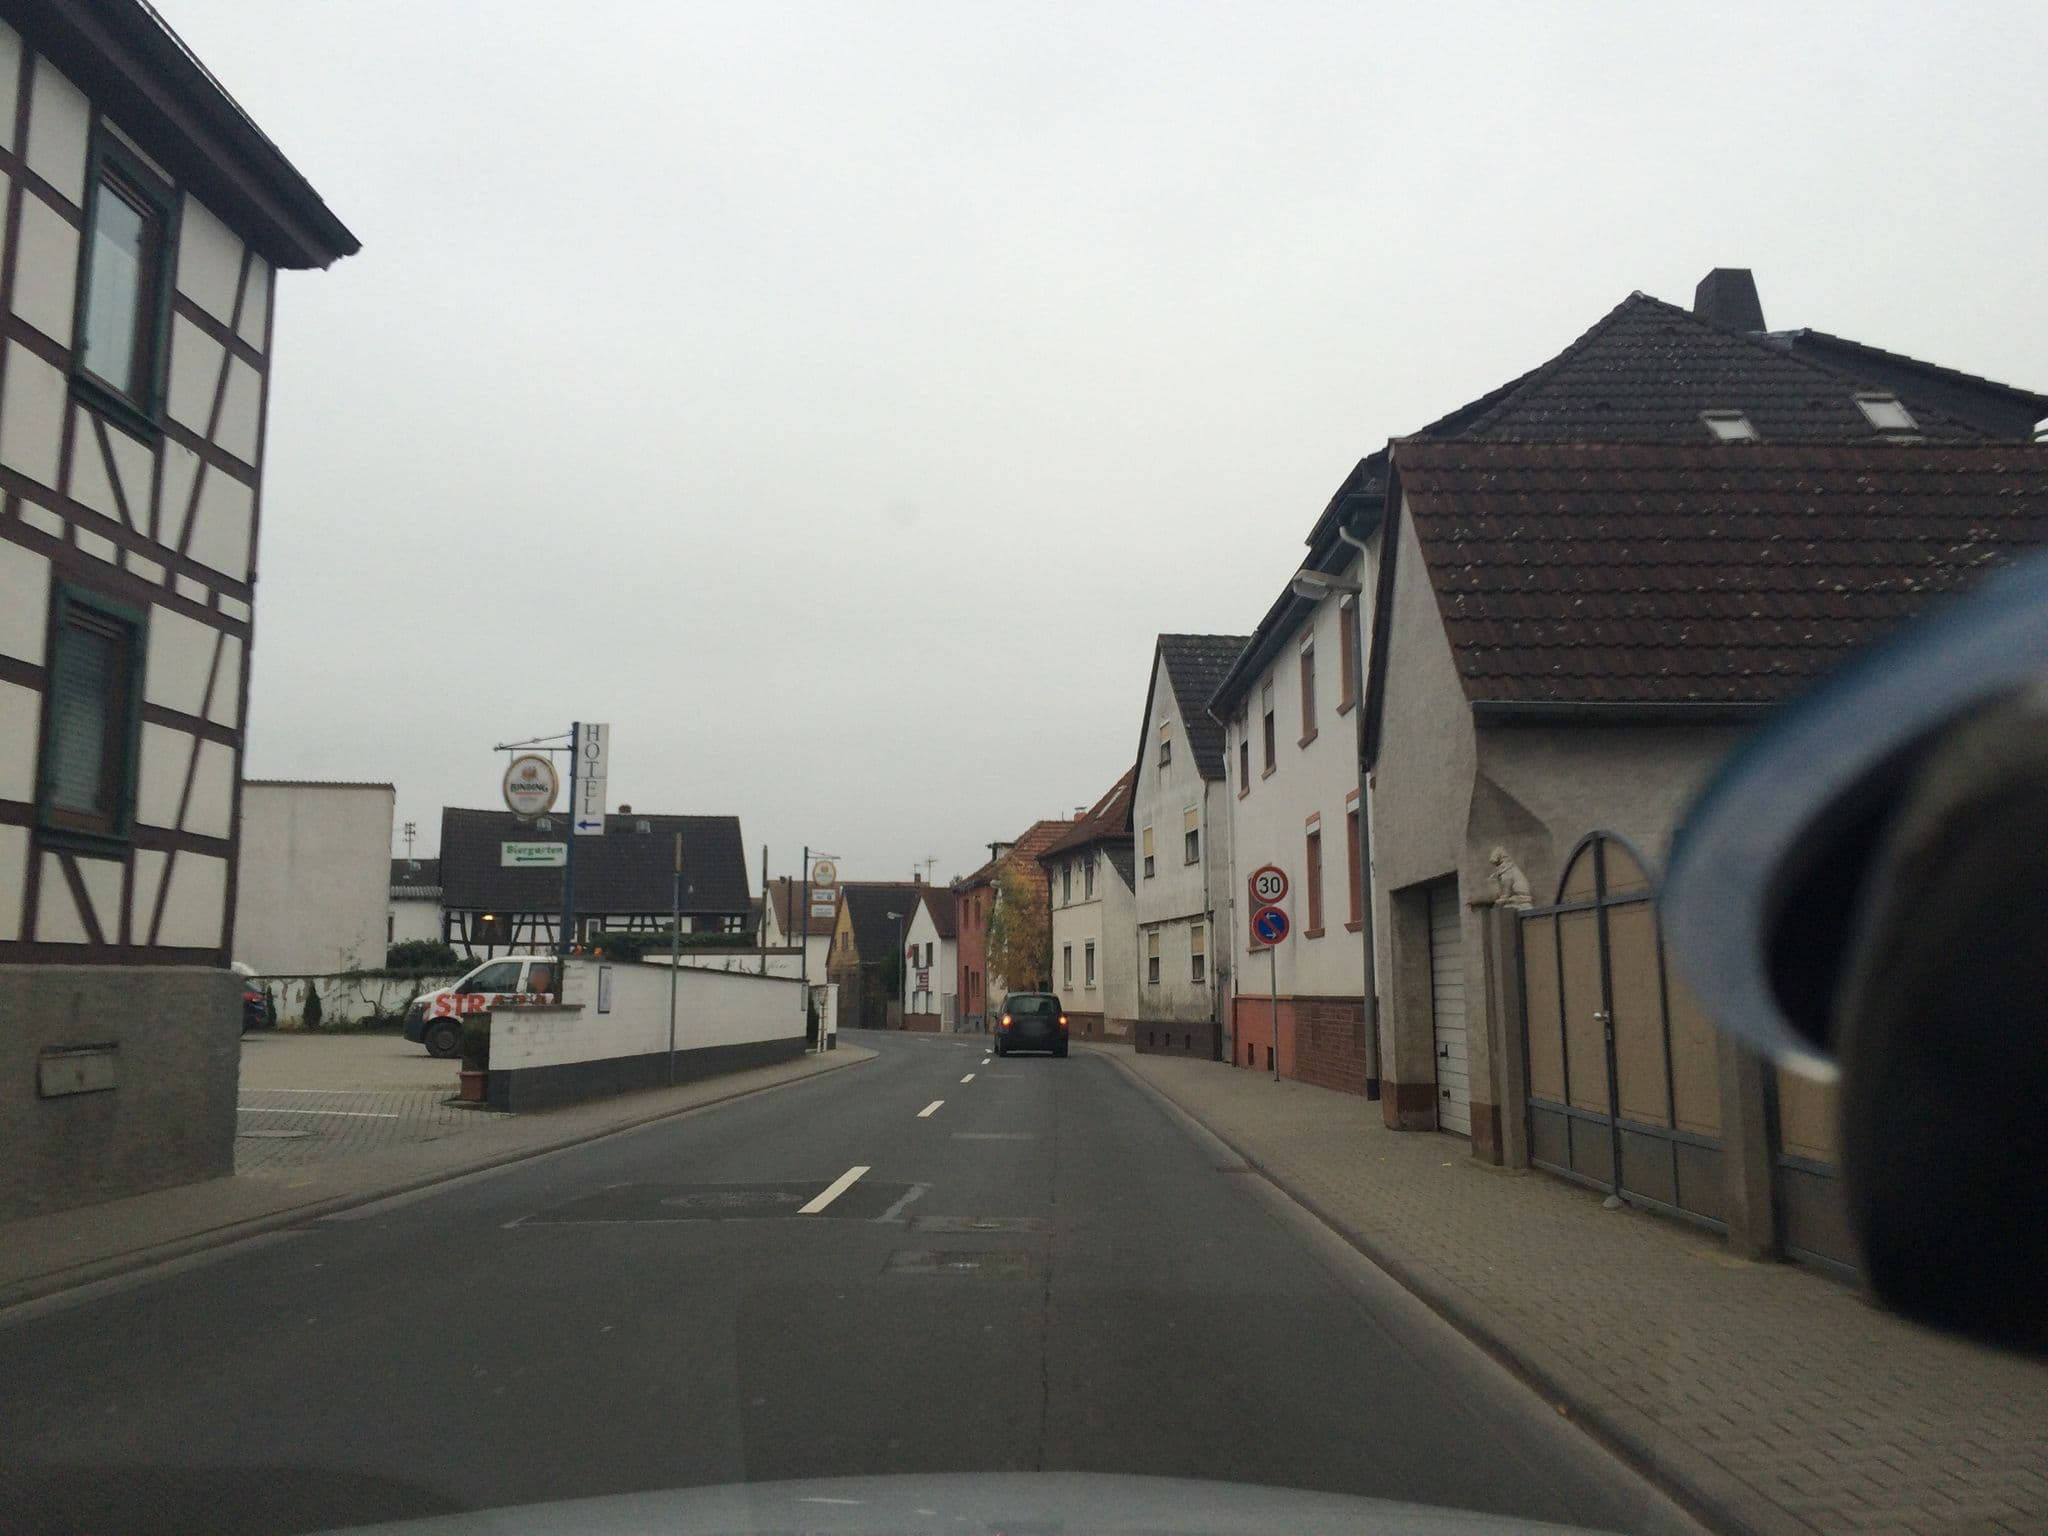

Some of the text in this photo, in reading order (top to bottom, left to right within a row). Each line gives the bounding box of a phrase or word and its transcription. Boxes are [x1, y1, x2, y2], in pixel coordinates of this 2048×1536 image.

[585, 724, 600, 816] HOTEL
[506, 845, 563, 856] Biergarten
[1259, 877, 1281, 894] 30
